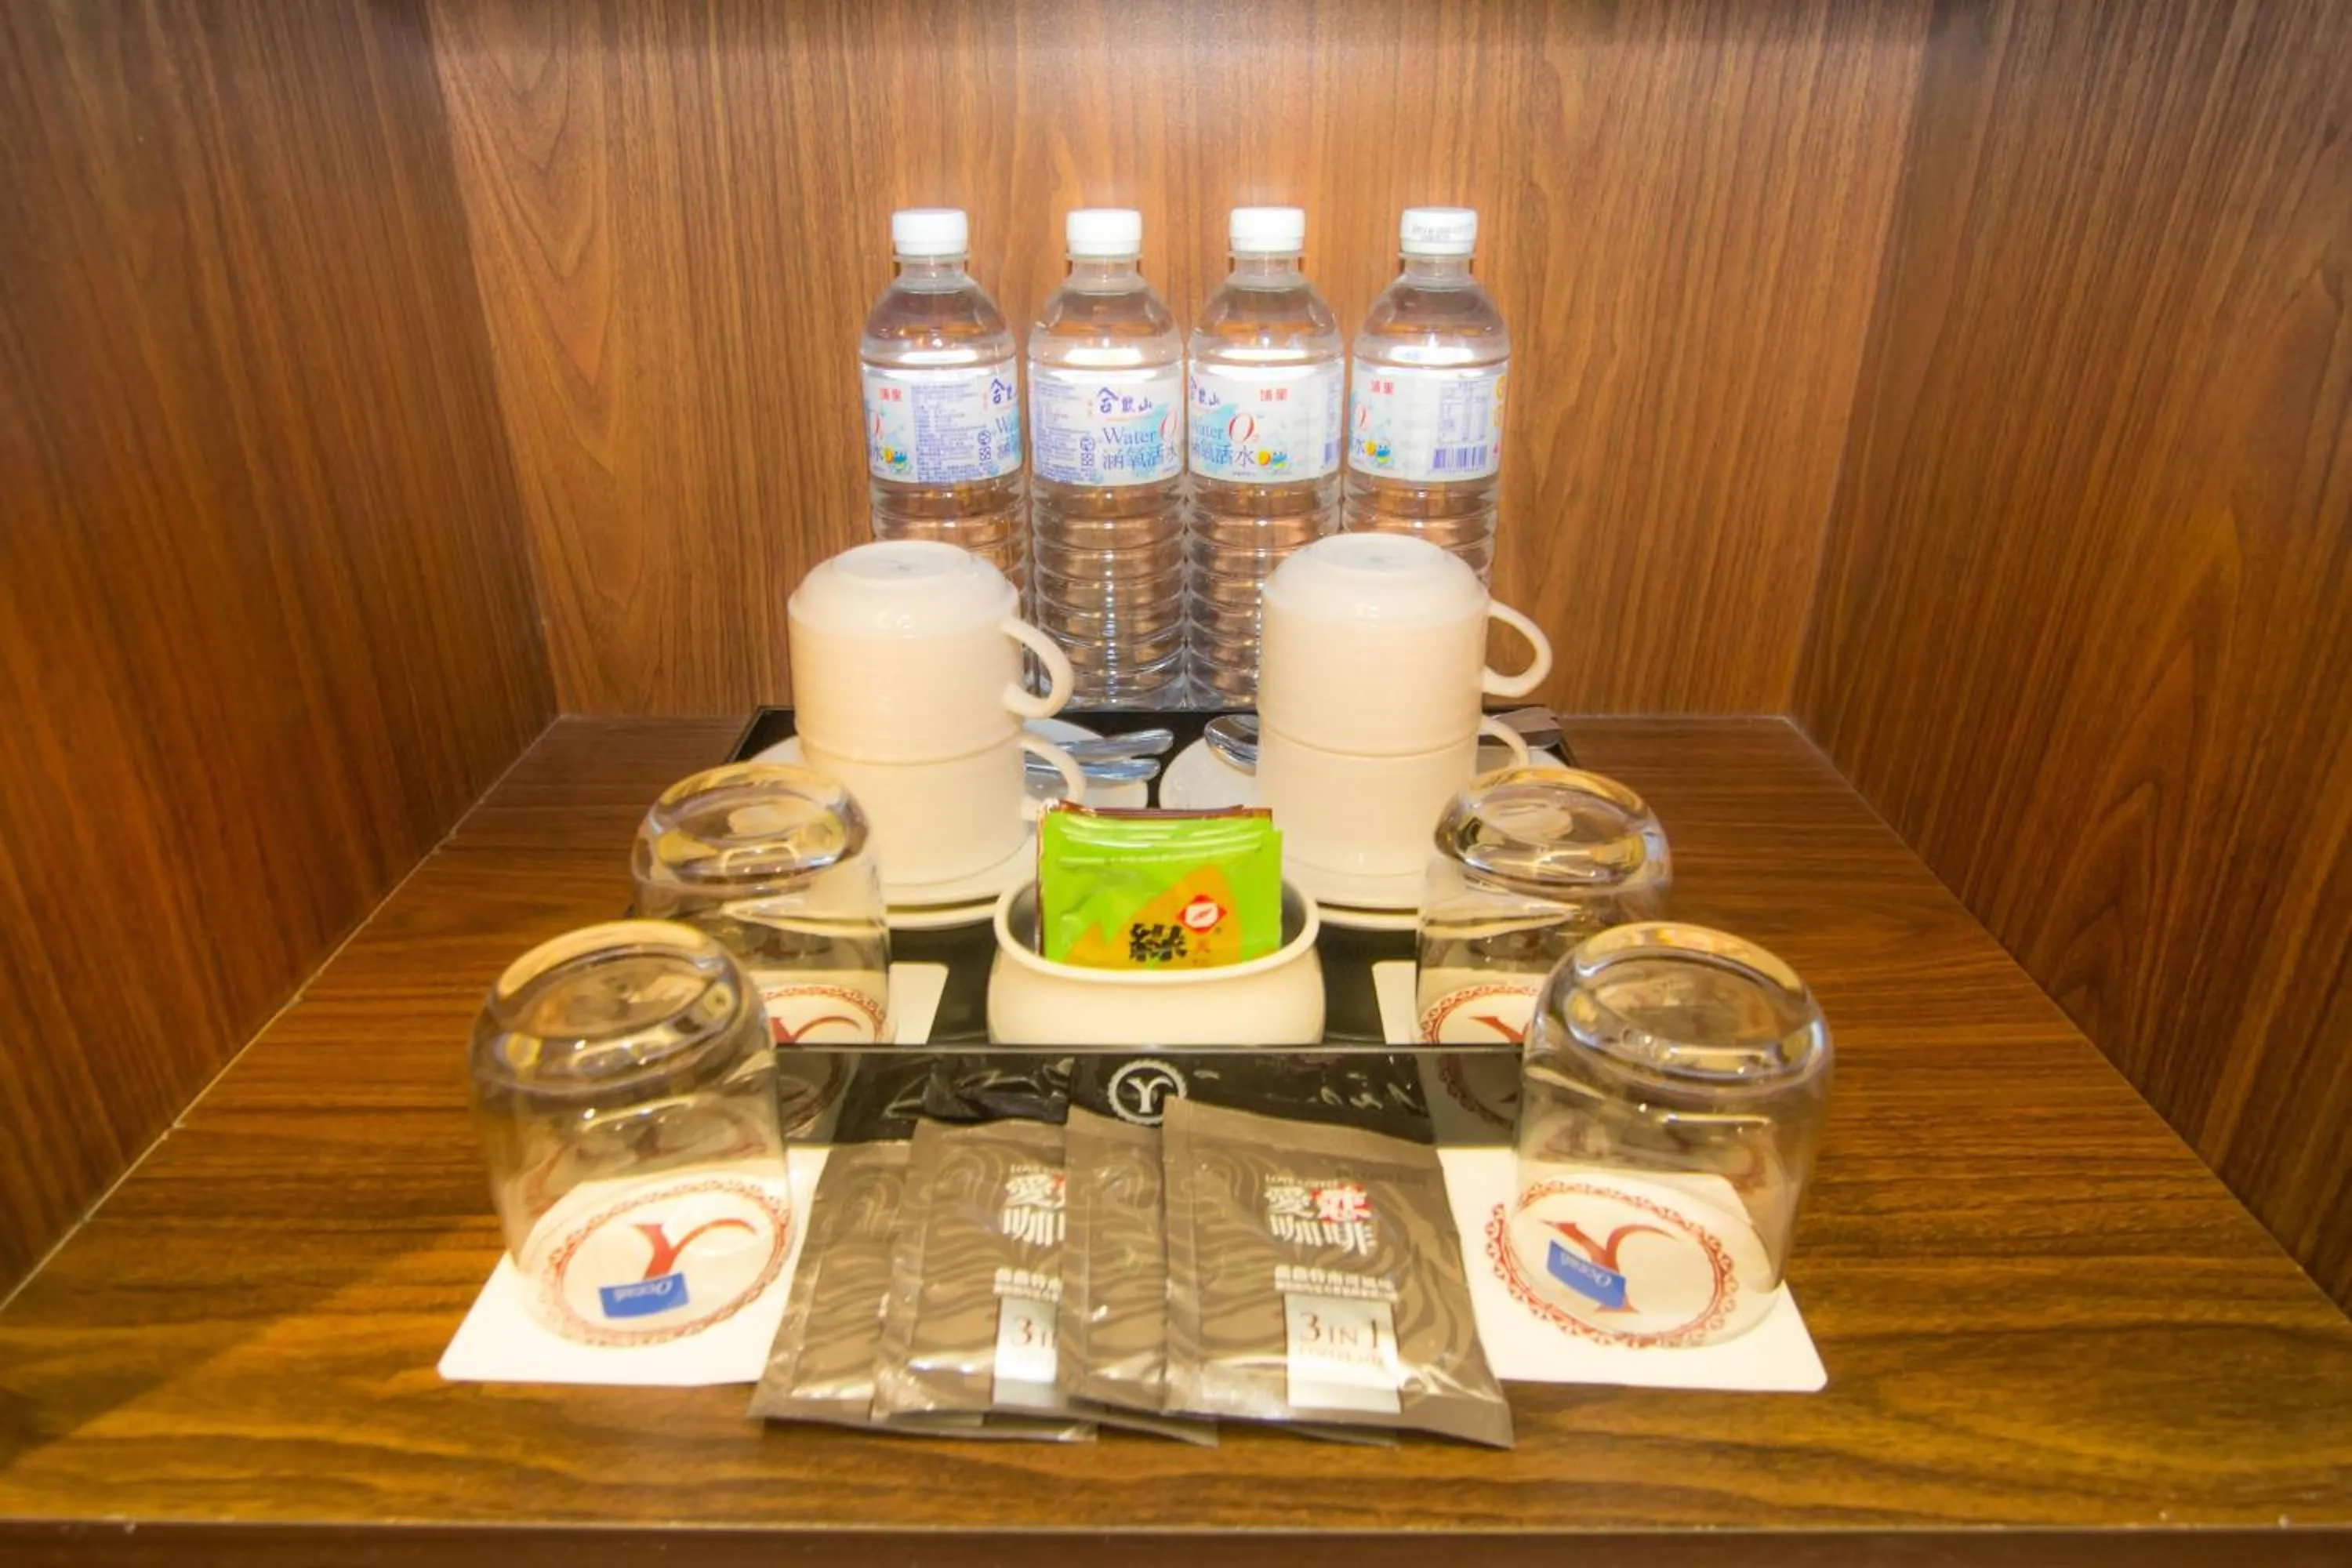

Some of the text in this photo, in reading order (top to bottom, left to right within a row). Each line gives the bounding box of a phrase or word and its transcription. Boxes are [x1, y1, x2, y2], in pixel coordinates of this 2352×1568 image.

[1002, 1207, 1065, 1247] 咖
[1014, 1316, 1033, 1345] 3
[1300, 1311, 1378, 1350] 3 IN 1
